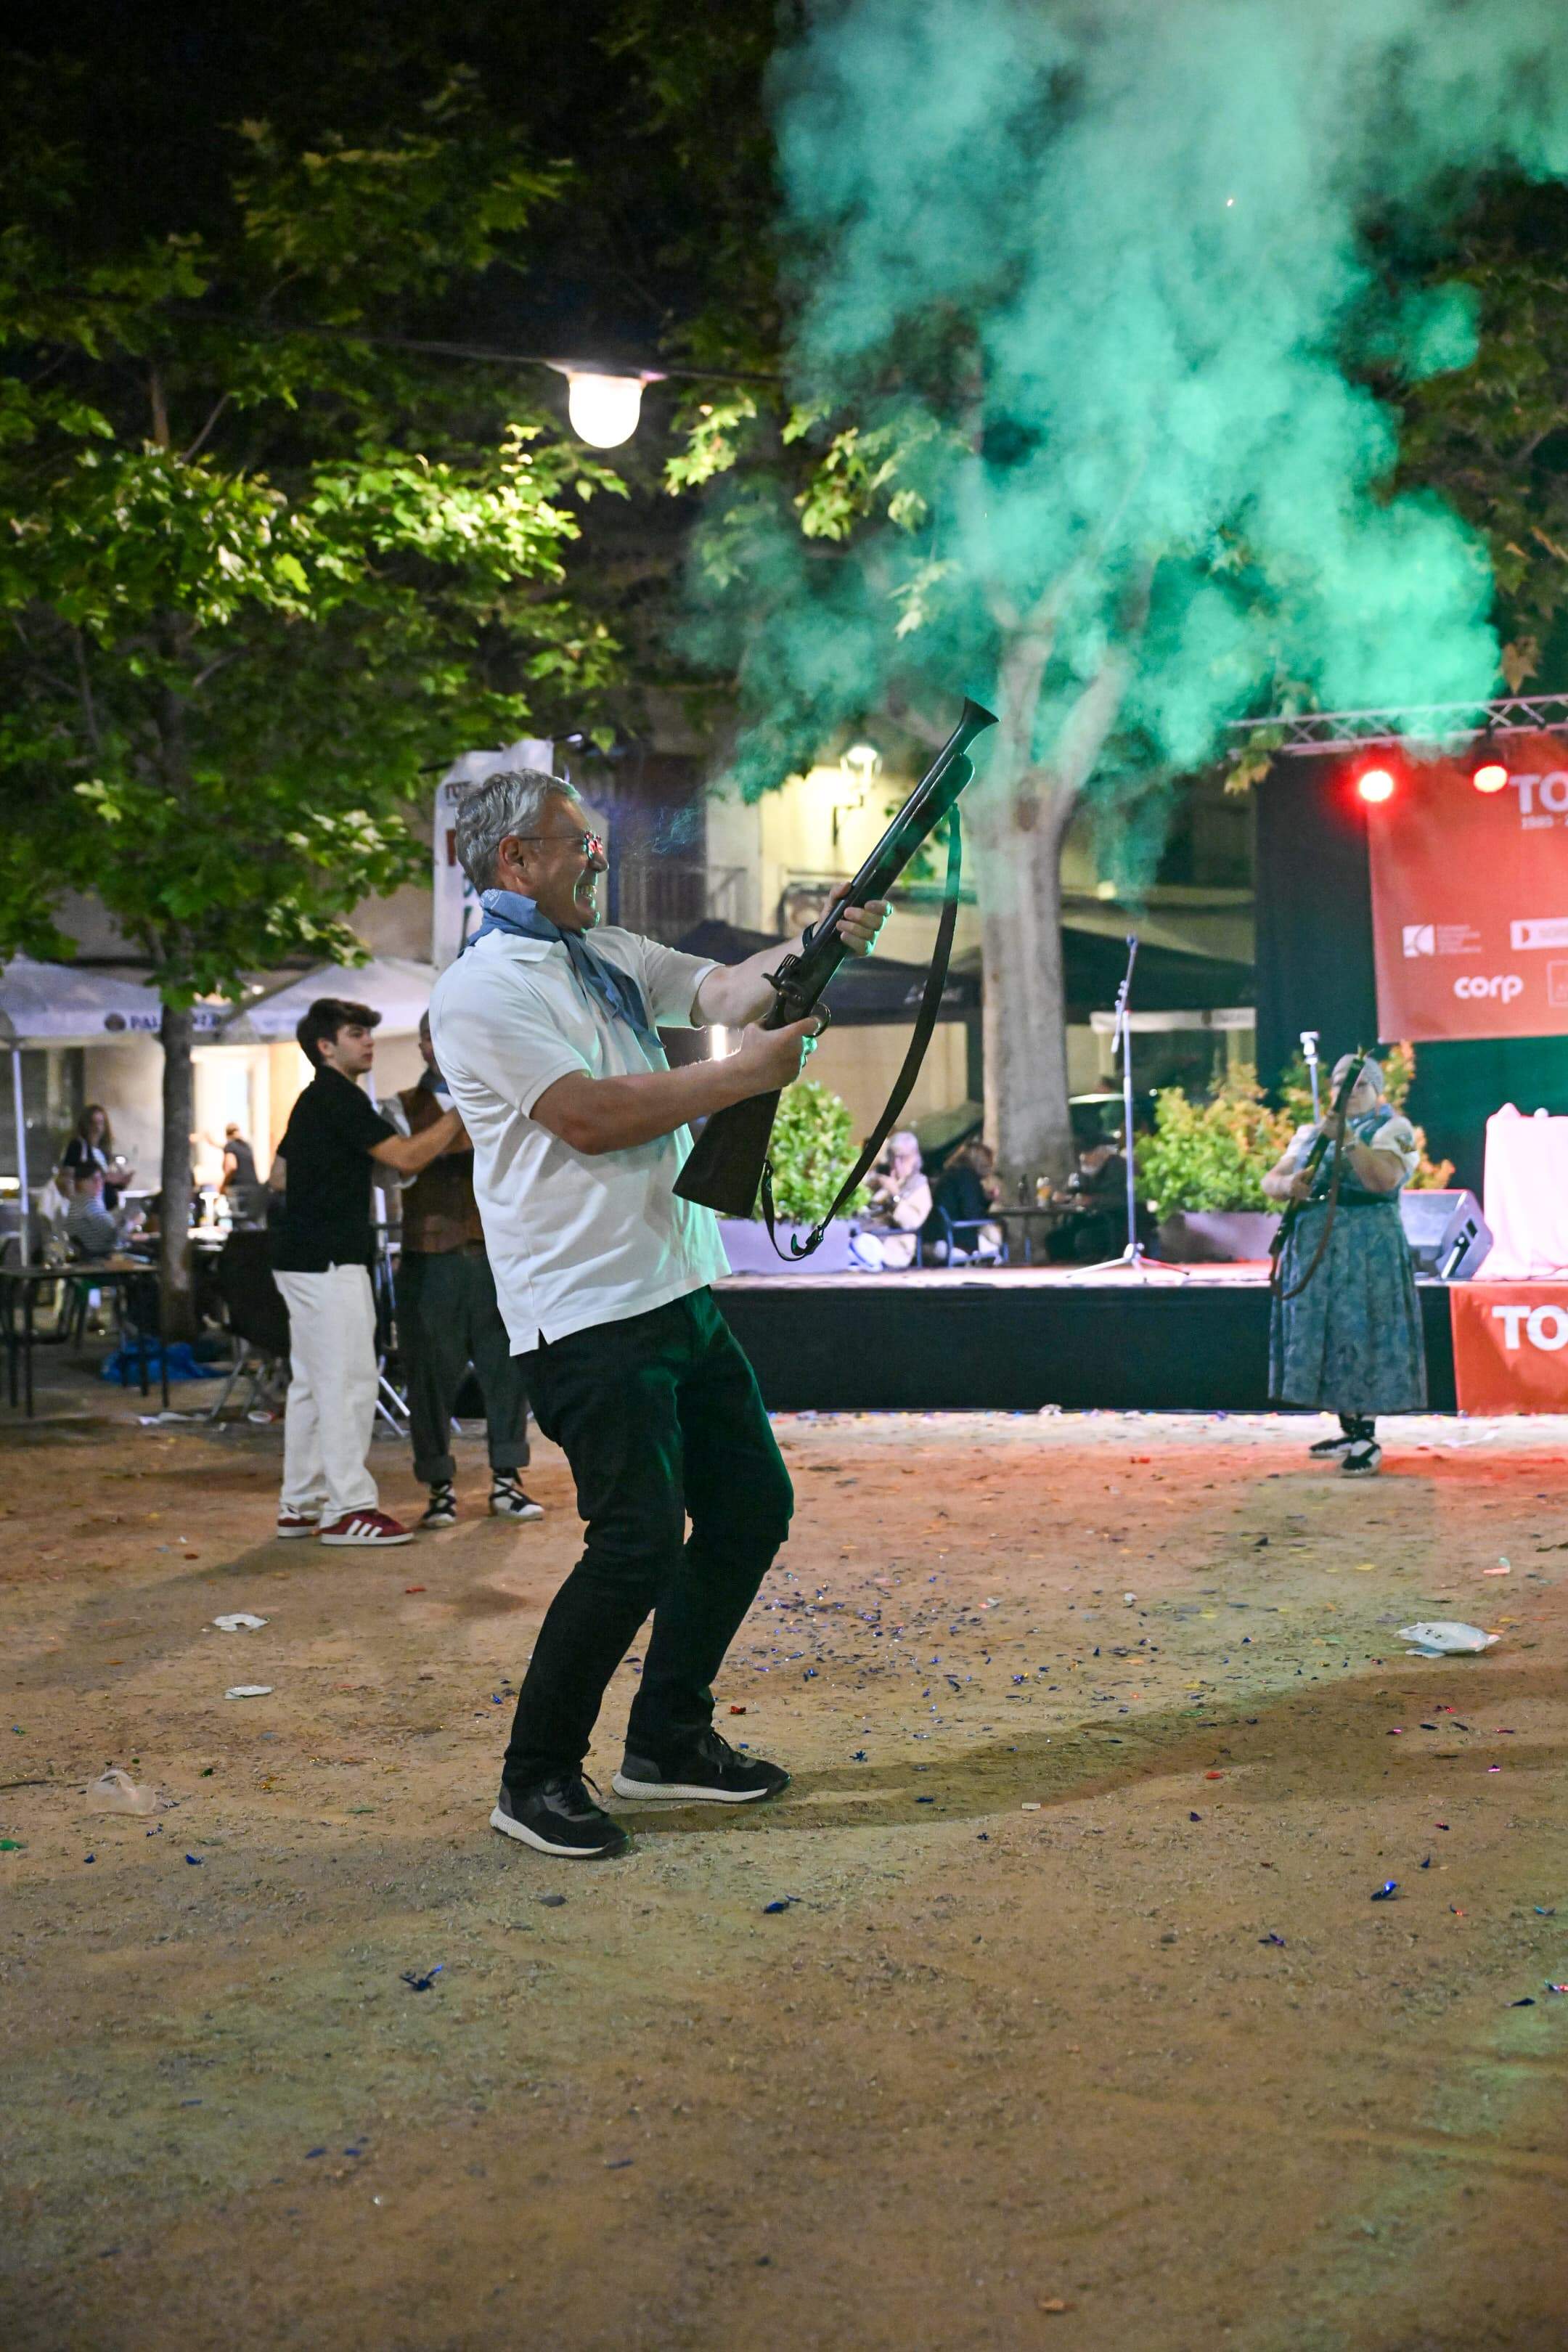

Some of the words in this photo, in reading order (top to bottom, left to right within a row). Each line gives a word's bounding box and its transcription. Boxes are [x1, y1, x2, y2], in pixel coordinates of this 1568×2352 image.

[1509, 772, 1568, 813] TO
[1454, 974, 1524, 1004] corp
[1492, 1304, 1568, 1351] TO
